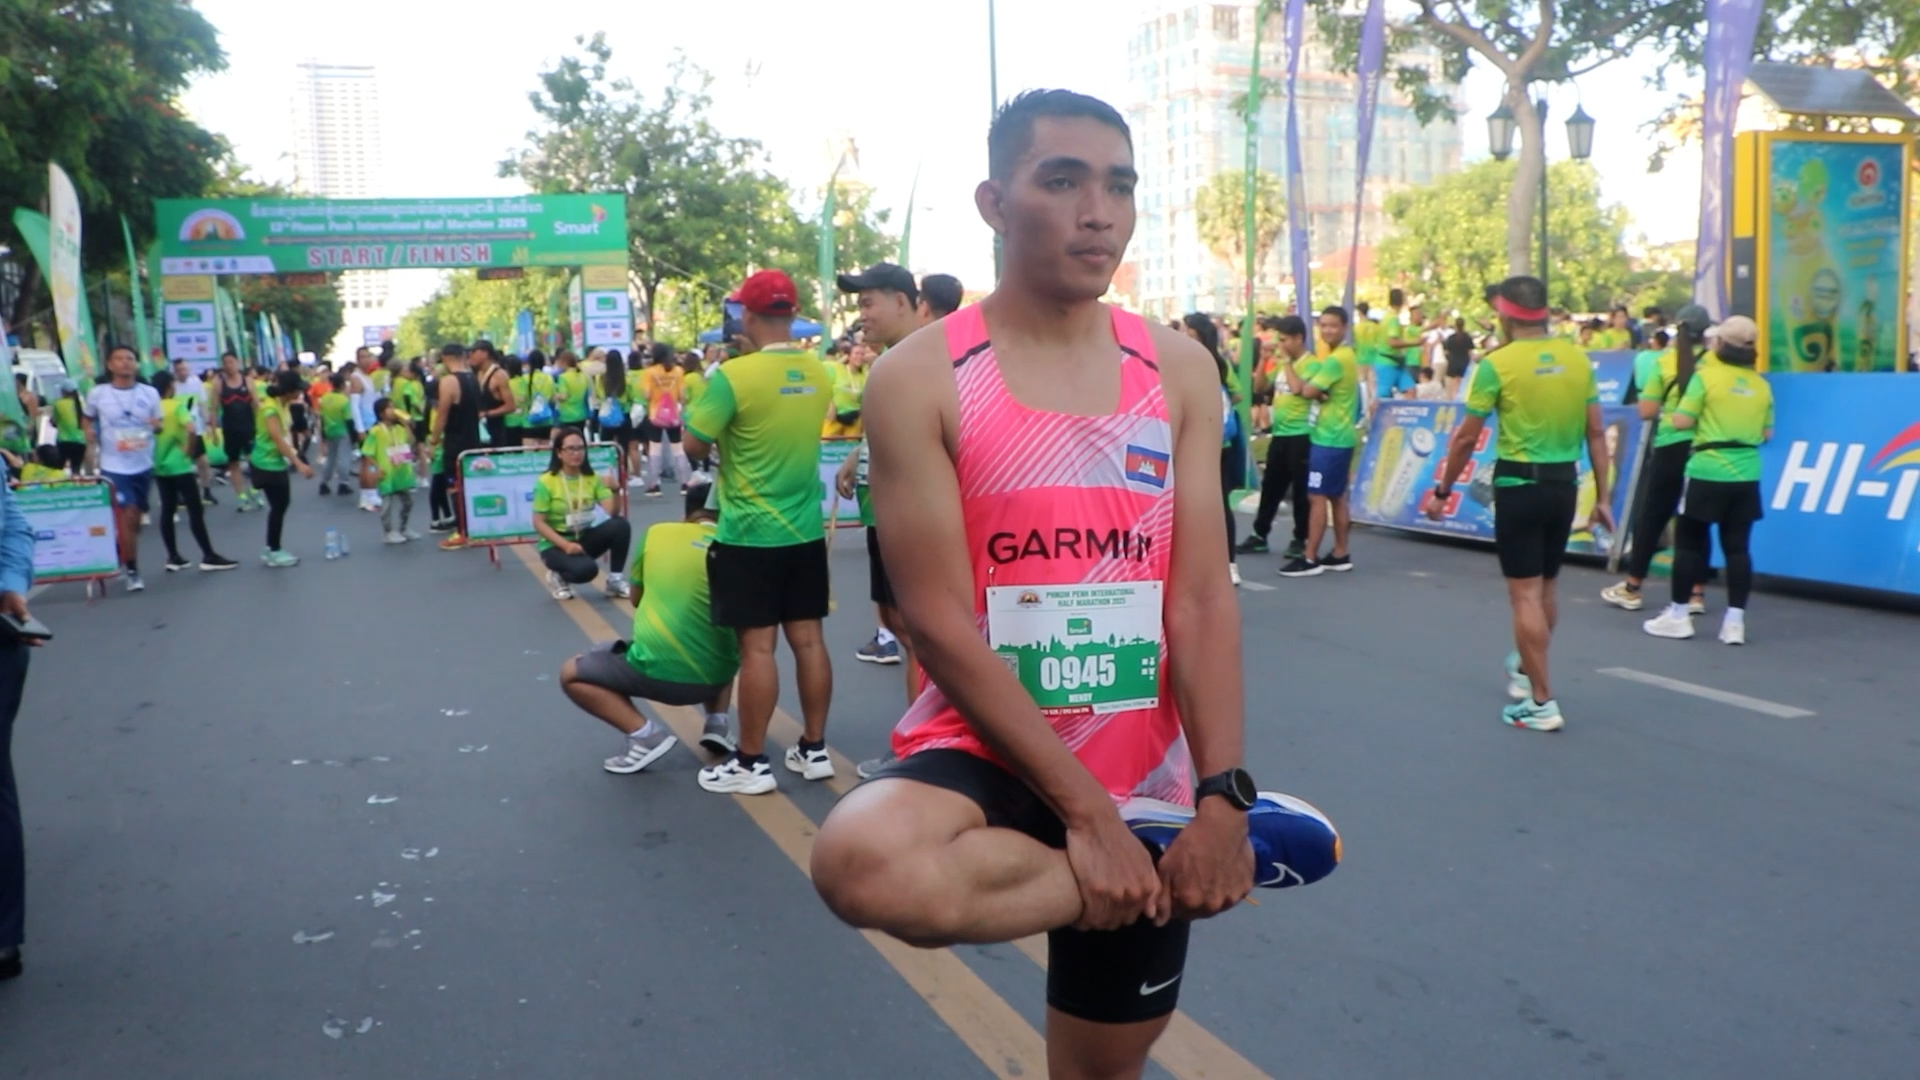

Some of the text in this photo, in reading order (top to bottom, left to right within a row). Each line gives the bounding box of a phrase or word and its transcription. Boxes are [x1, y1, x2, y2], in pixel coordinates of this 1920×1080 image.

[553, 221, 600, 236] Smart
[307, 246, 386, 268] START
[407, 243, 492, 265] FINISH
[987, 528, 1152, 565] GARMIN
[1040, 653, 1116, 691] 0945
